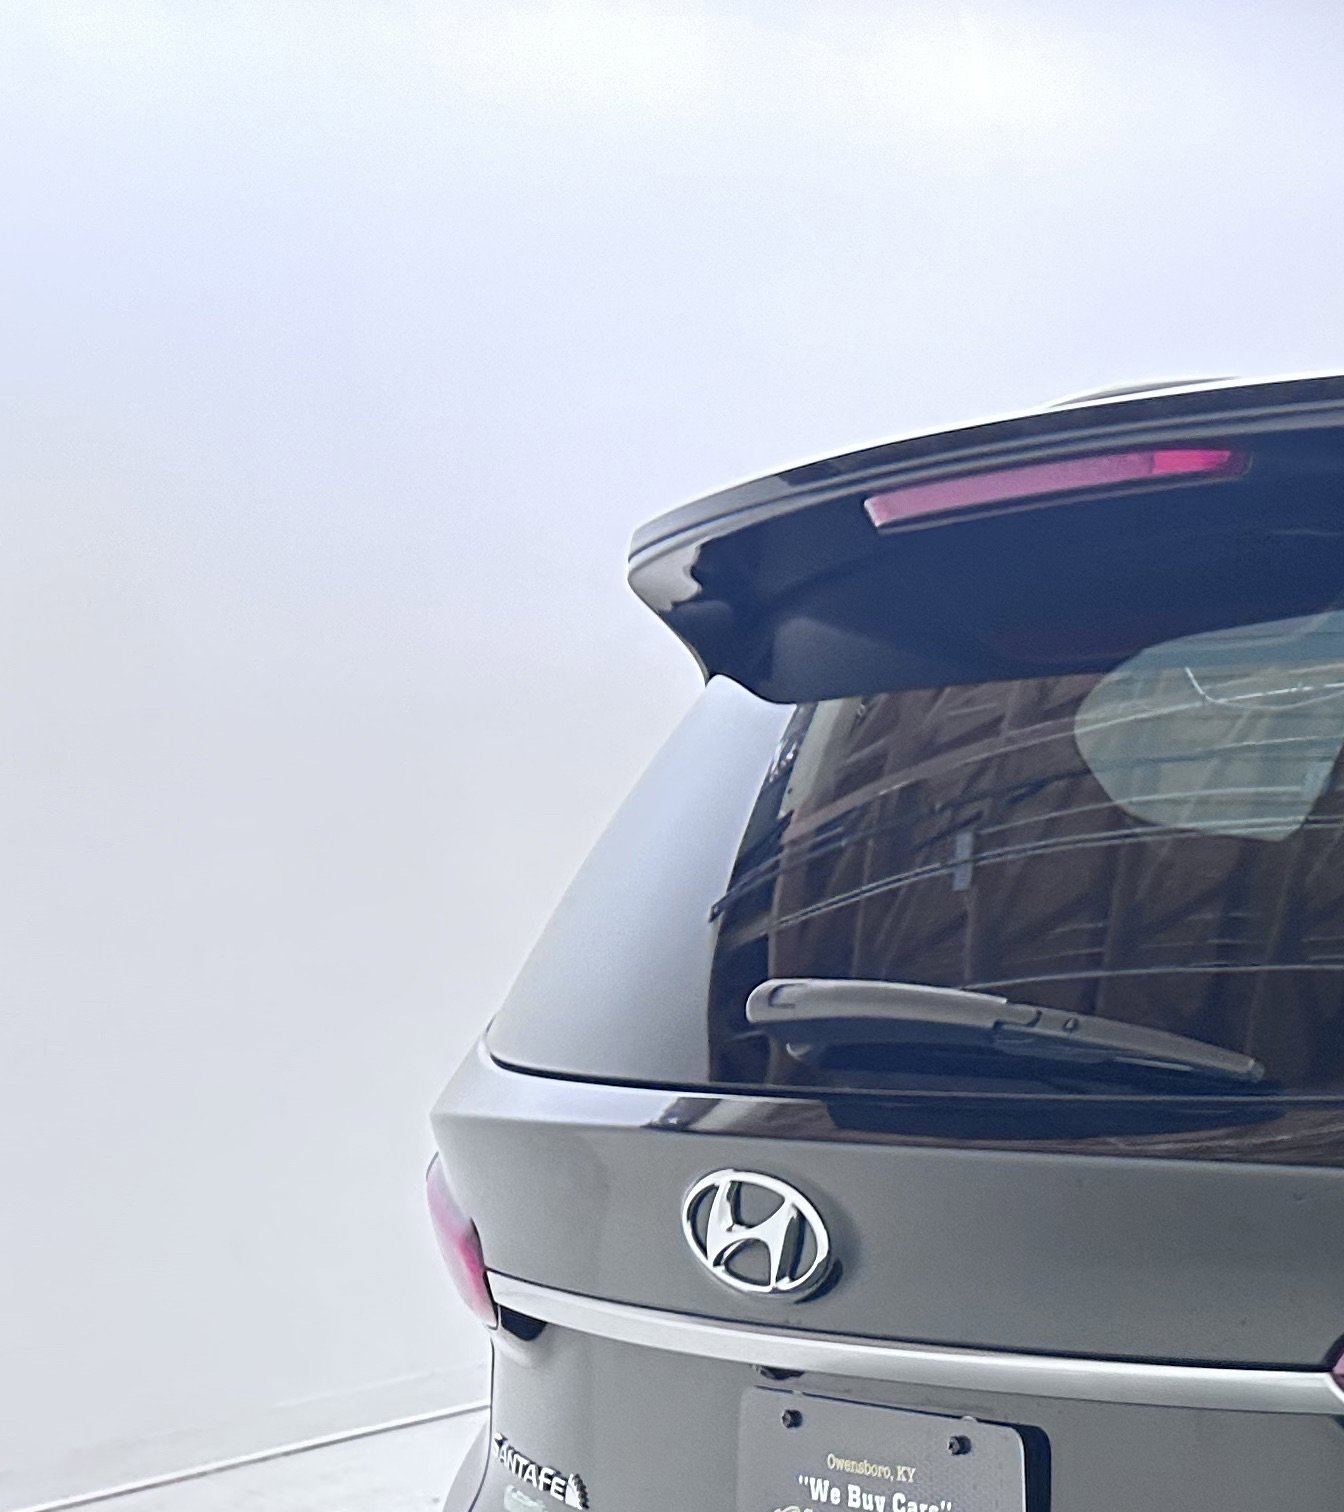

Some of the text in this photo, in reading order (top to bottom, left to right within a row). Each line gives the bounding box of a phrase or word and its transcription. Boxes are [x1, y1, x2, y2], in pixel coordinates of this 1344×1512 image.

[827, 1453, 917, 1484] Owensboro, KY
[798, 1475, 841, 1505] "We
